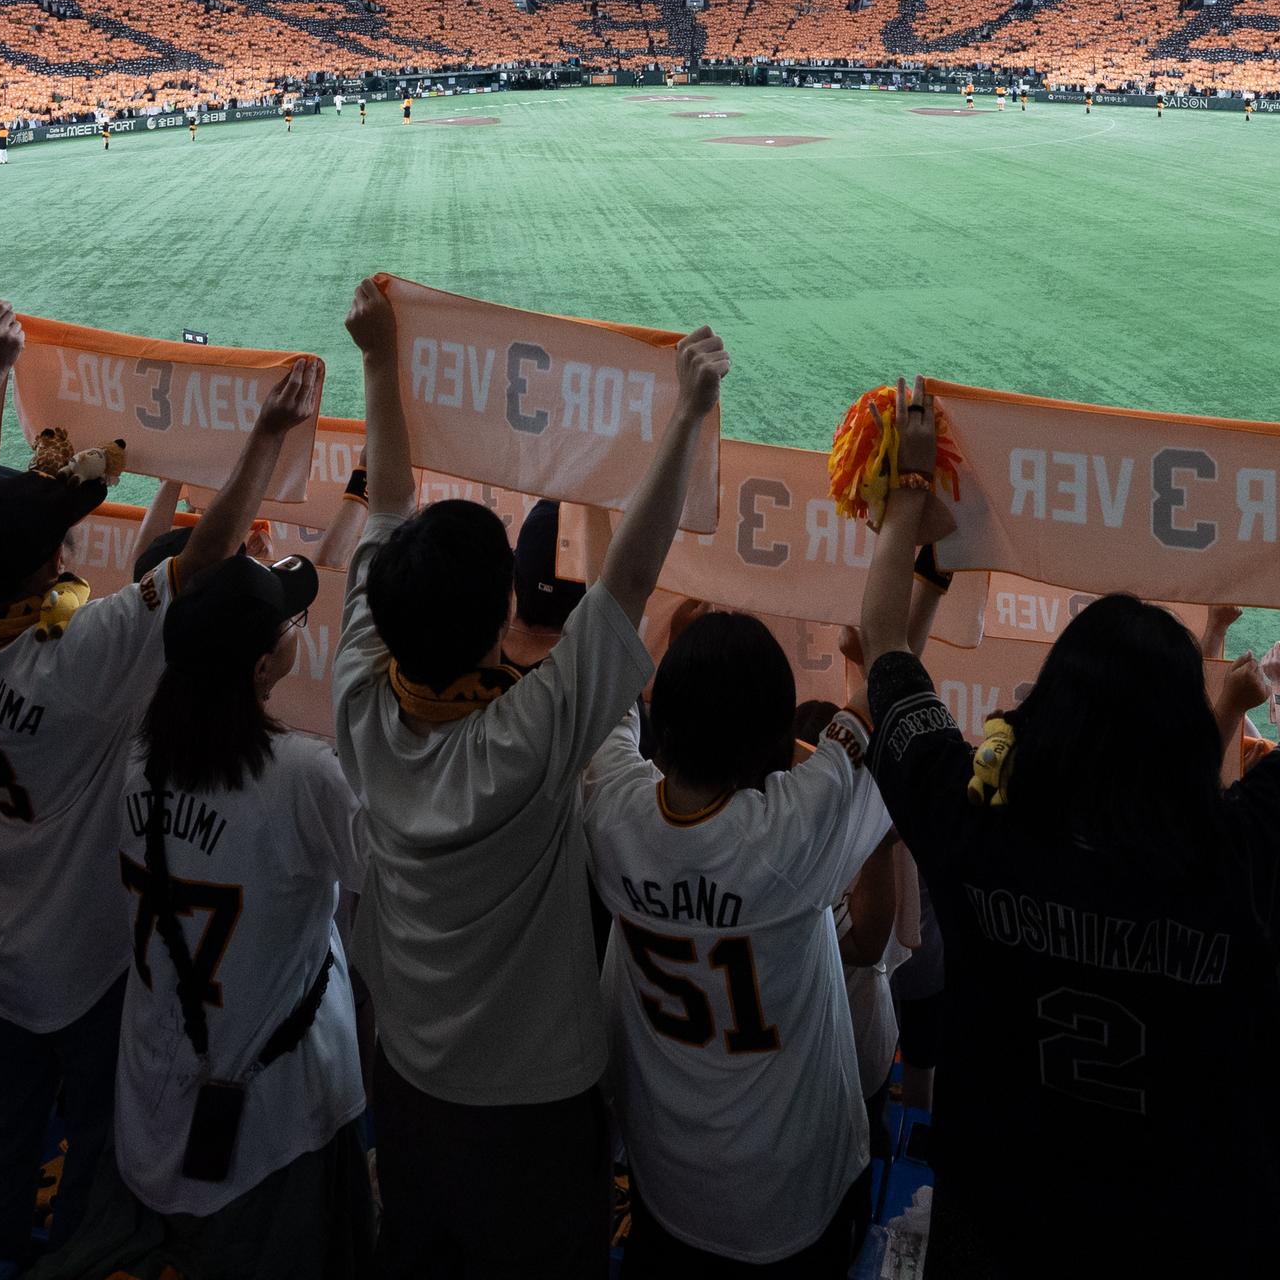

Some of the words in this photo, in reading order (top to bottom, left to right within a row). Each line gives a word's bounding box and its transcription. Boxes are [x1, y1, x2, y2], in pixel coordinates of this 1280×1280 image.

[108, 120, 136, 132] PORT
[1162, 96, 1208, 109] SAISON
[622, 875, 743, 930] ASANO
[962, 881, 1233, 987] YOSHIKAWA
[621, 920, 783, 1055] 51
[1036, 984, 1148, 1118] 2
